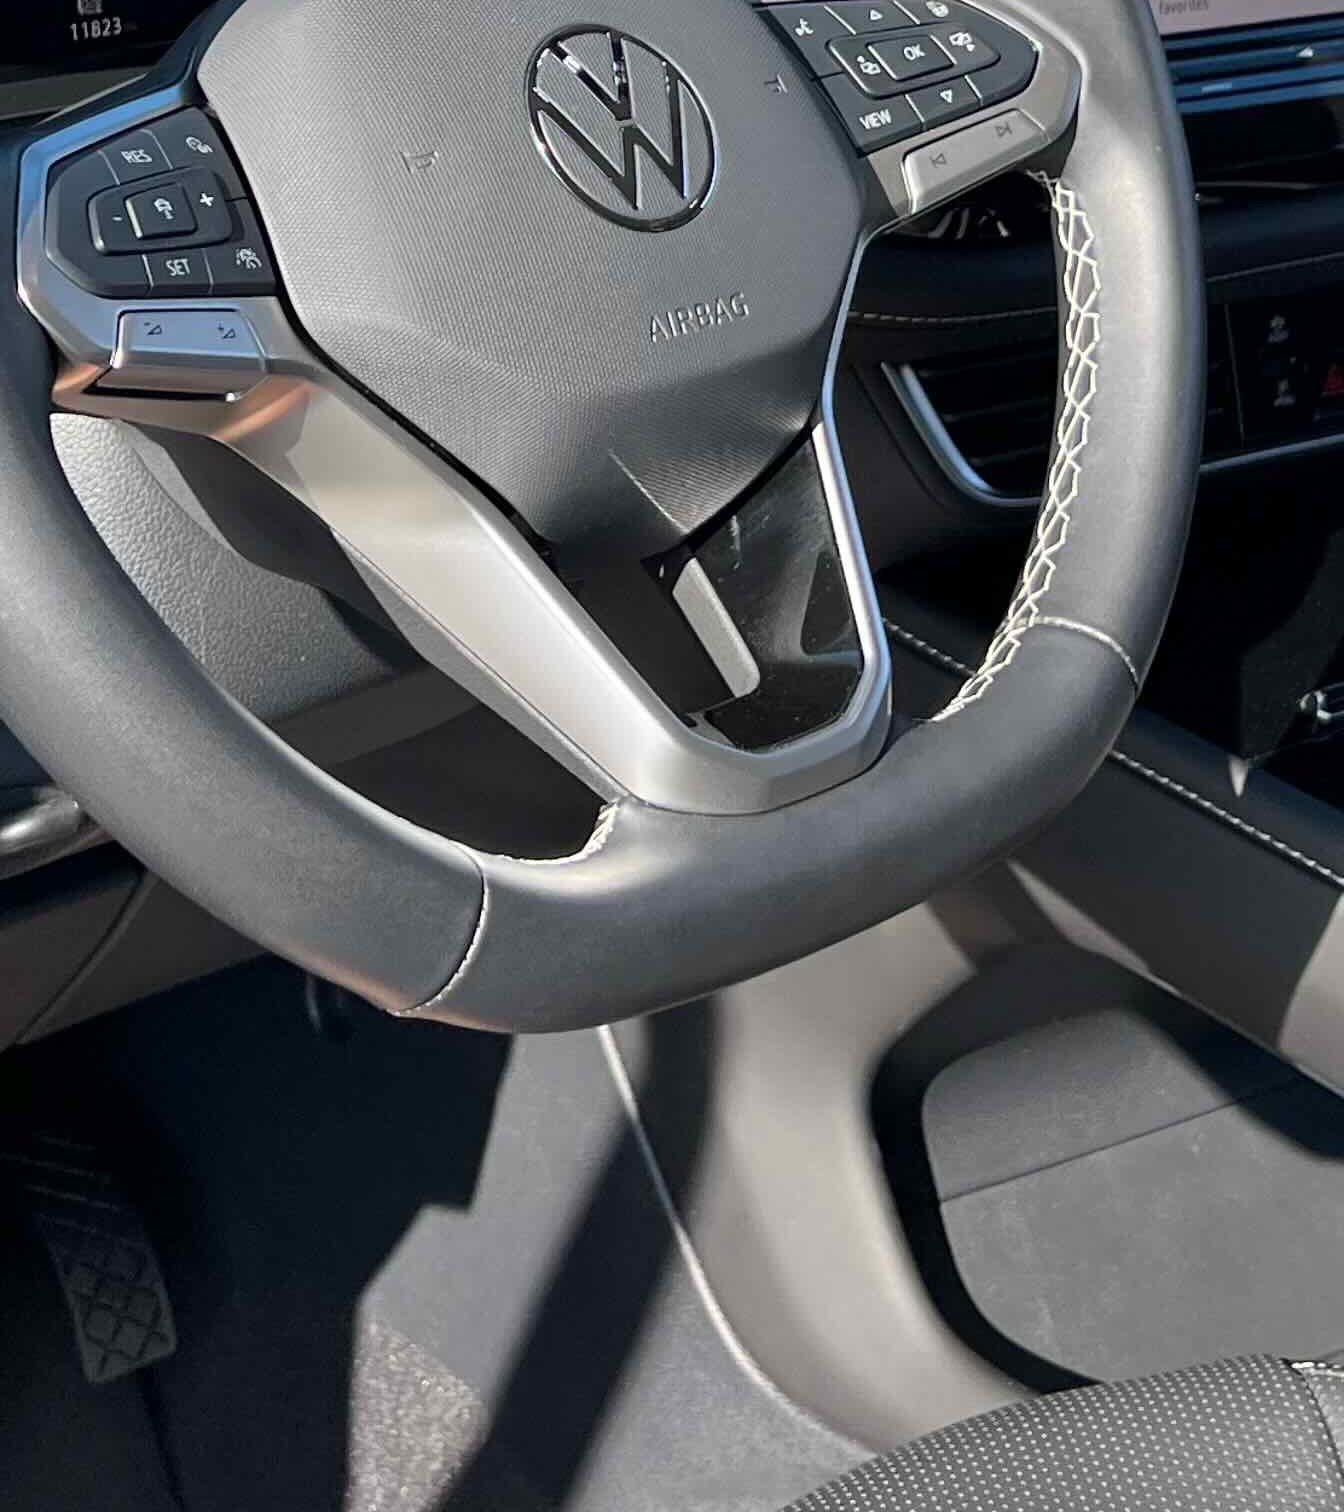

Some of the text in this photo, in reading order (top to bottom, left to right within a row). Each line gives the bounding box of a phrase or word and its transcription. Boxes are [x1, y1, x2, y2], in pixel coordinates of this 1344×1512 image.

[70, 16, 123, 41] 11823
[903, 44, 926, 62] OK
[858, 108, 893, 131] VIEW
[121, 148, 153, 165] RES
[166, 257, 192, 277] SET
[648, 291, 751, 344] AIRBAG
